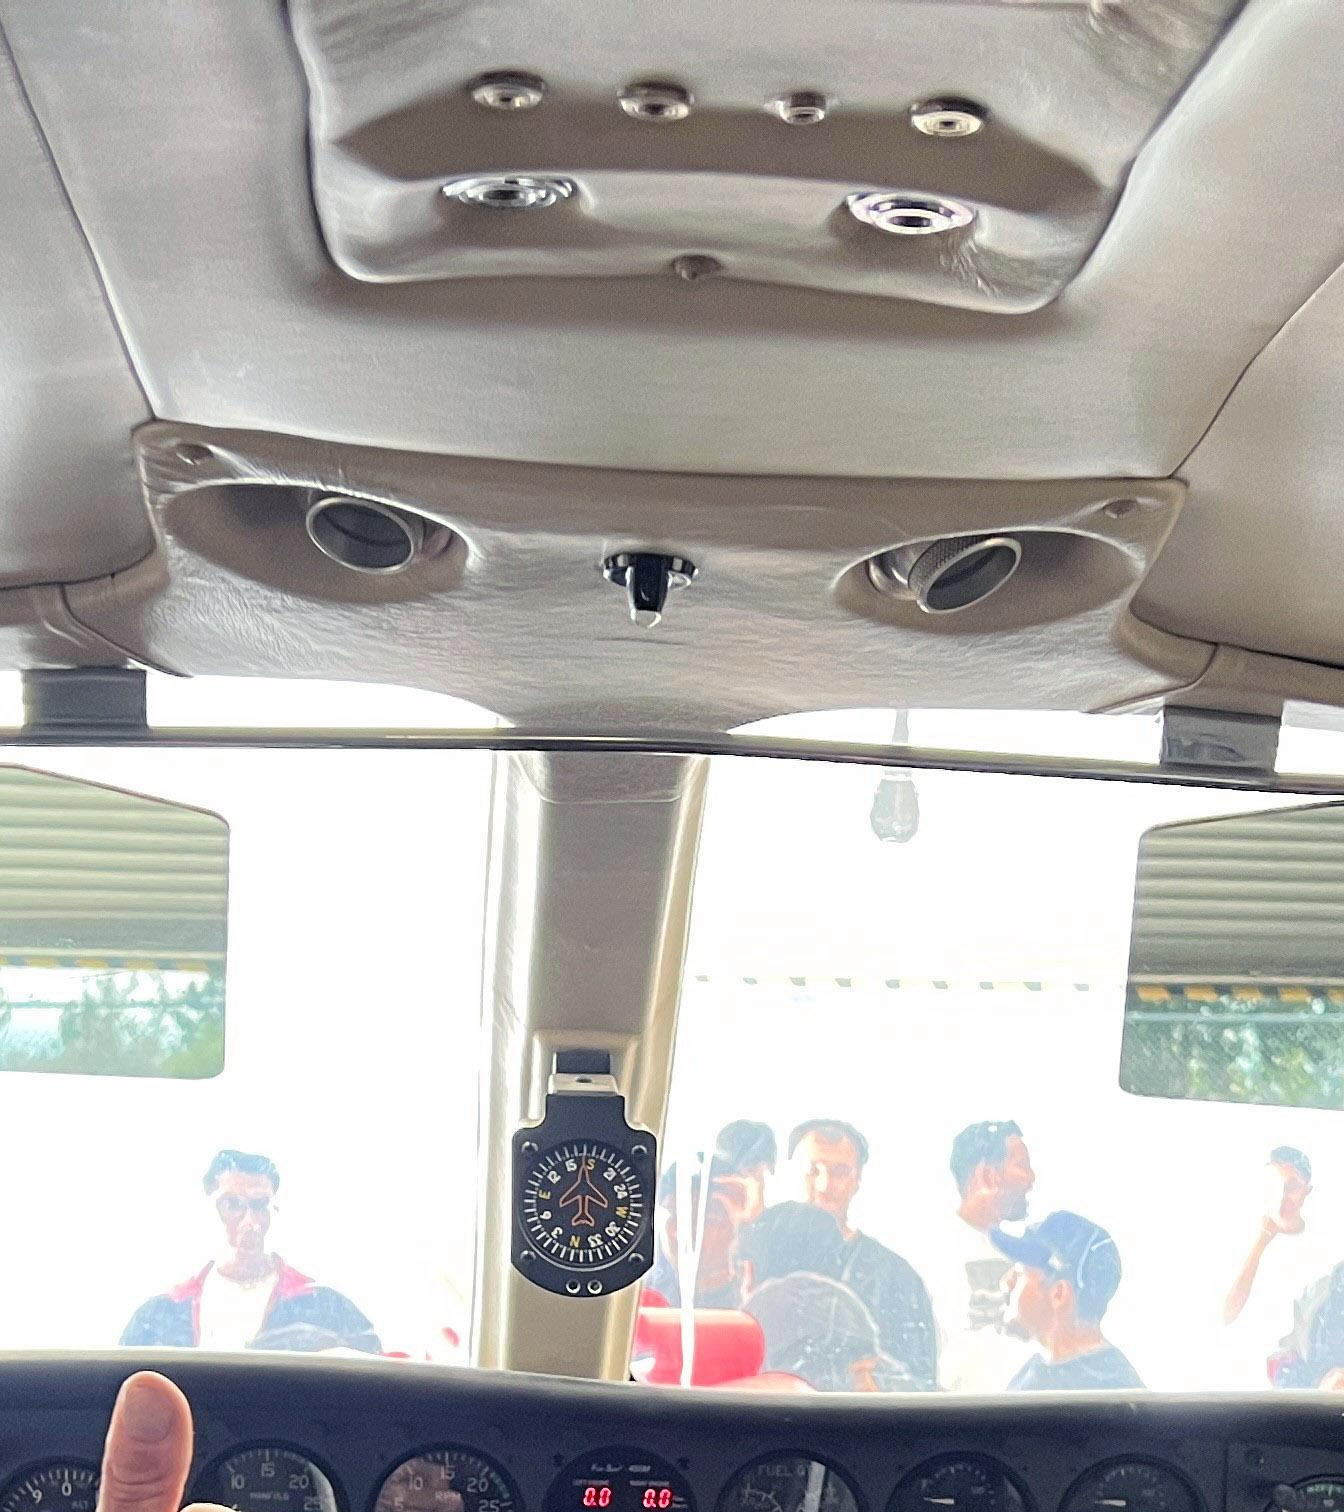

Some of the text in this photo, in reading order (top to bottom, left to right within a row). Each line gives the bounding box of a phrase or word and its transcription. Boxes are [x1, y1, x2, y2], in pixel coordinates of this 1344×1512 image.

[565, 1159, 578, 1172] 15
[586, 1158, 596, 1170] S
[547, 1170, 562, 1184] 12
[602, 1167, 617, 1182] 21
[538, 1190, 551, 1200] E
[614, 1184, 628, 1200] 24
[540, 1210, 552, 1220] 6
[616, 1206, 628, 1217] W
[551, 1226, 563, 1240] 3
[604, 1221, 621, 1238] 30
[570, 1236, 581, 1248] N
[587, 1234, 604, 1248] 33
[260, 1463, 276, 1477] 15
[440, 1465, 456, 1480] 15
[758, 1464, 792, 1477] FUEL
[62, 1482, 72, 1496] 0
[230, 1475, 246, 1490] 10
[289, 1474, 310, 1490] 20
[408, 1477, 424, 1490] 10
[467, 1478, 488, 1492] 20
[32, 1489, 42, 1504] 9
[394, 1497, 406, 1511] 5
